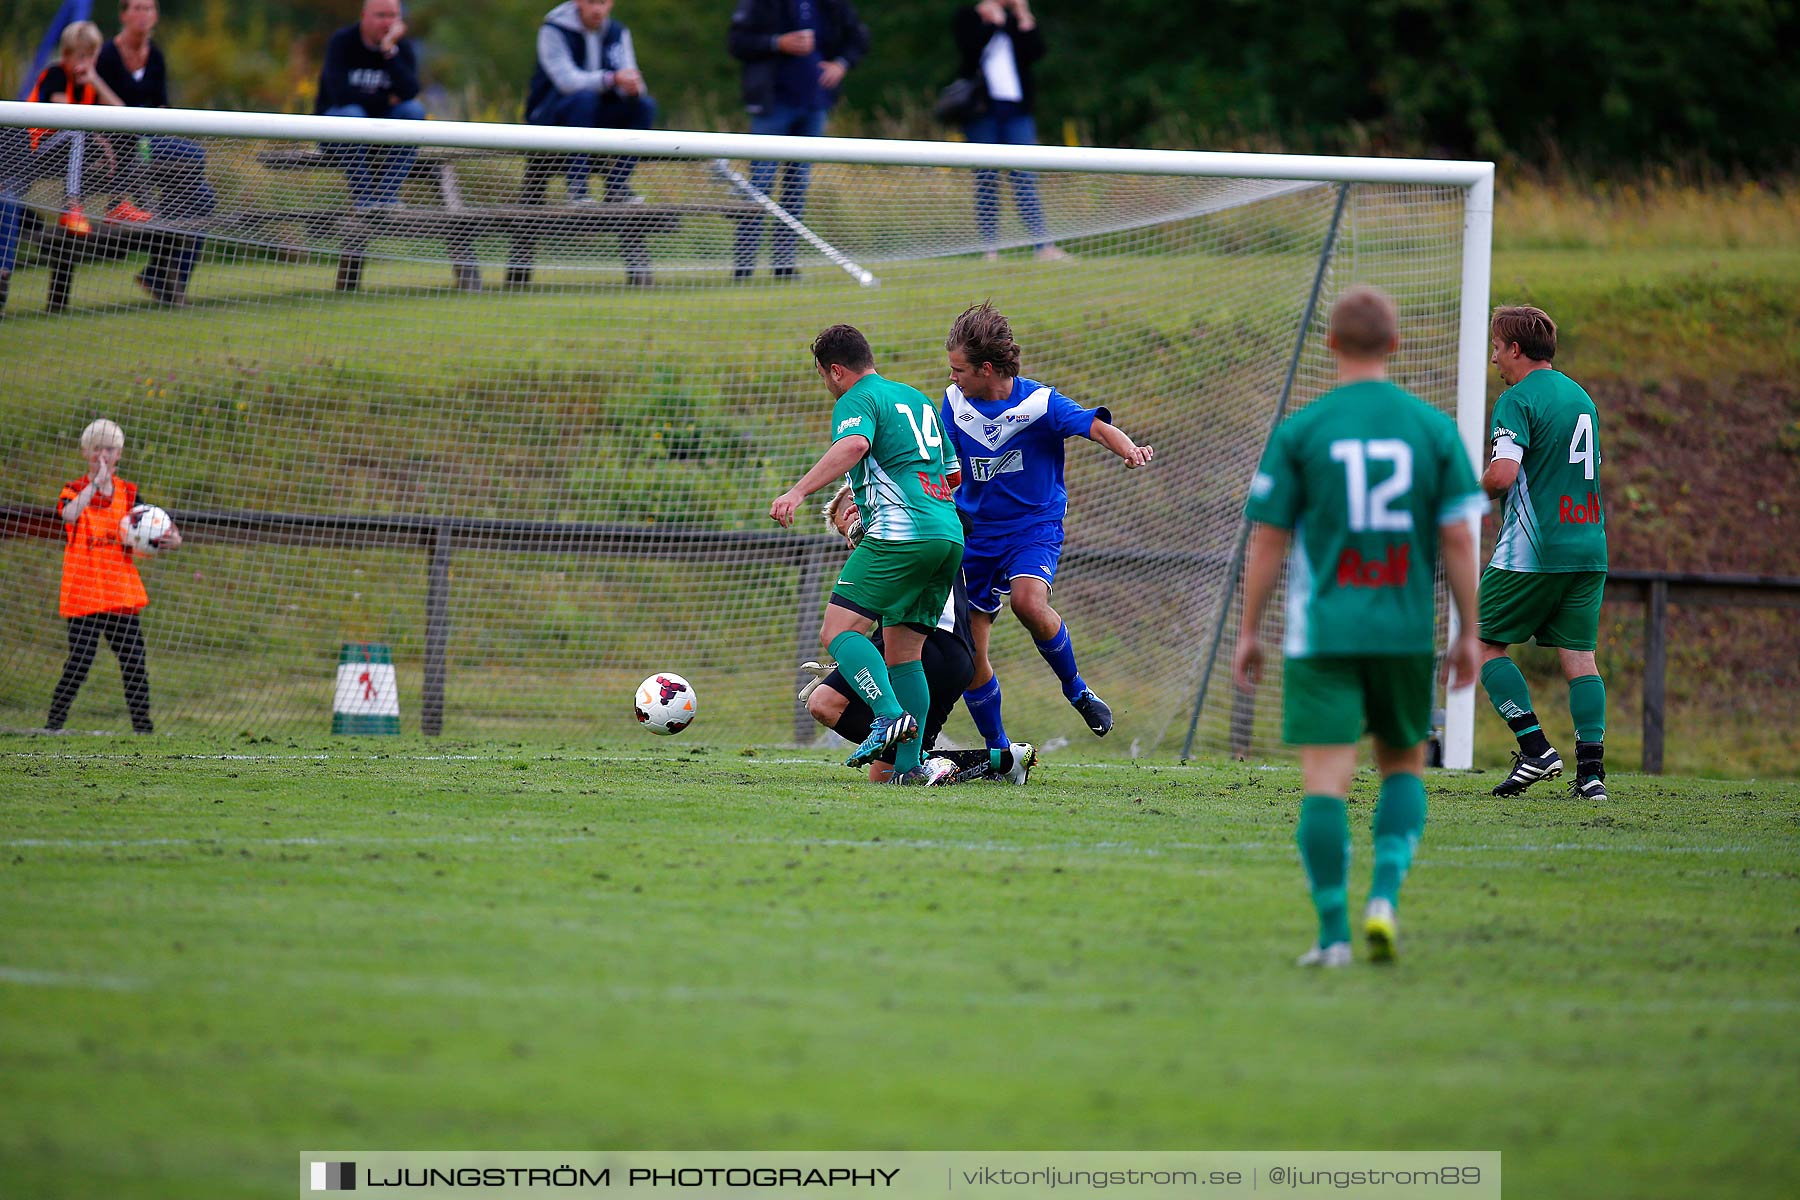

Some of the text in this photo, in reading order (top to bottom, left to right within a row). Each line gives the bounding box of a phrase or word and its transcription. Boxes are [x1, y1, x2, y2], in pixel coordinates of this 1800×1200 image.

[895, 403, 945, 464] 14
[1568, 413, 1595, 480] 4
[1330, 439, 1412, 531] 12
[1559, 492, 1601, 524] Rolf
[1337, 543, 1410, 587] Rolf
